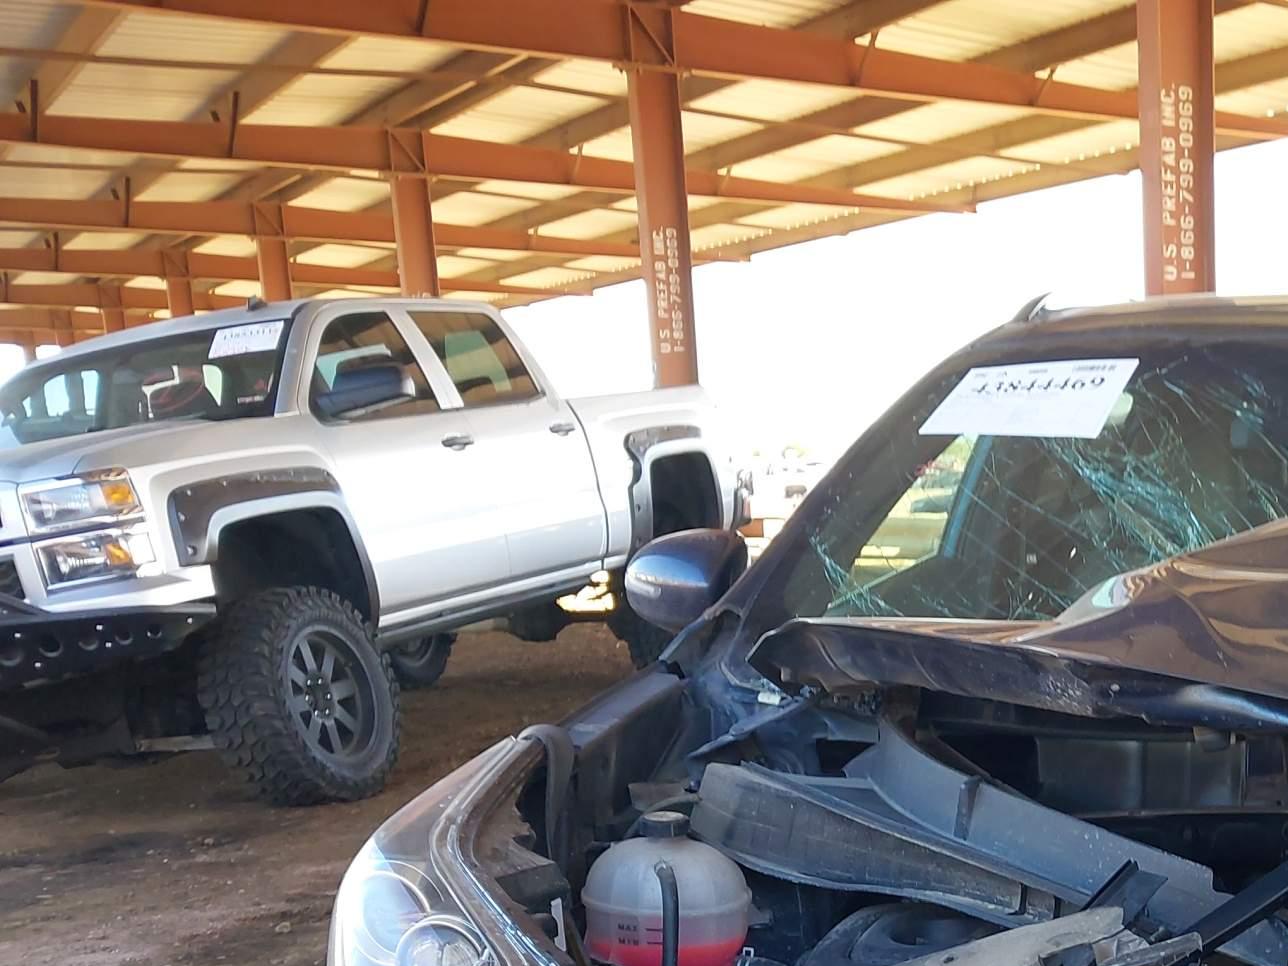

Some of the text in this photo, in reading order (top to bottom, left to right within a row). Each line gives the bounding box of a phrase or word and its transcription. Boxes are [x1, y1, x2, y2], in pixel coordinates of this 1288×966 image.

[1160, 82, 1176, 127] INC.
[1160, 136, 1177, 227] PREFAB
[1178, 85, 1196, 280] 1-866-799-0969
[617, 922, 638, 932] MAX
